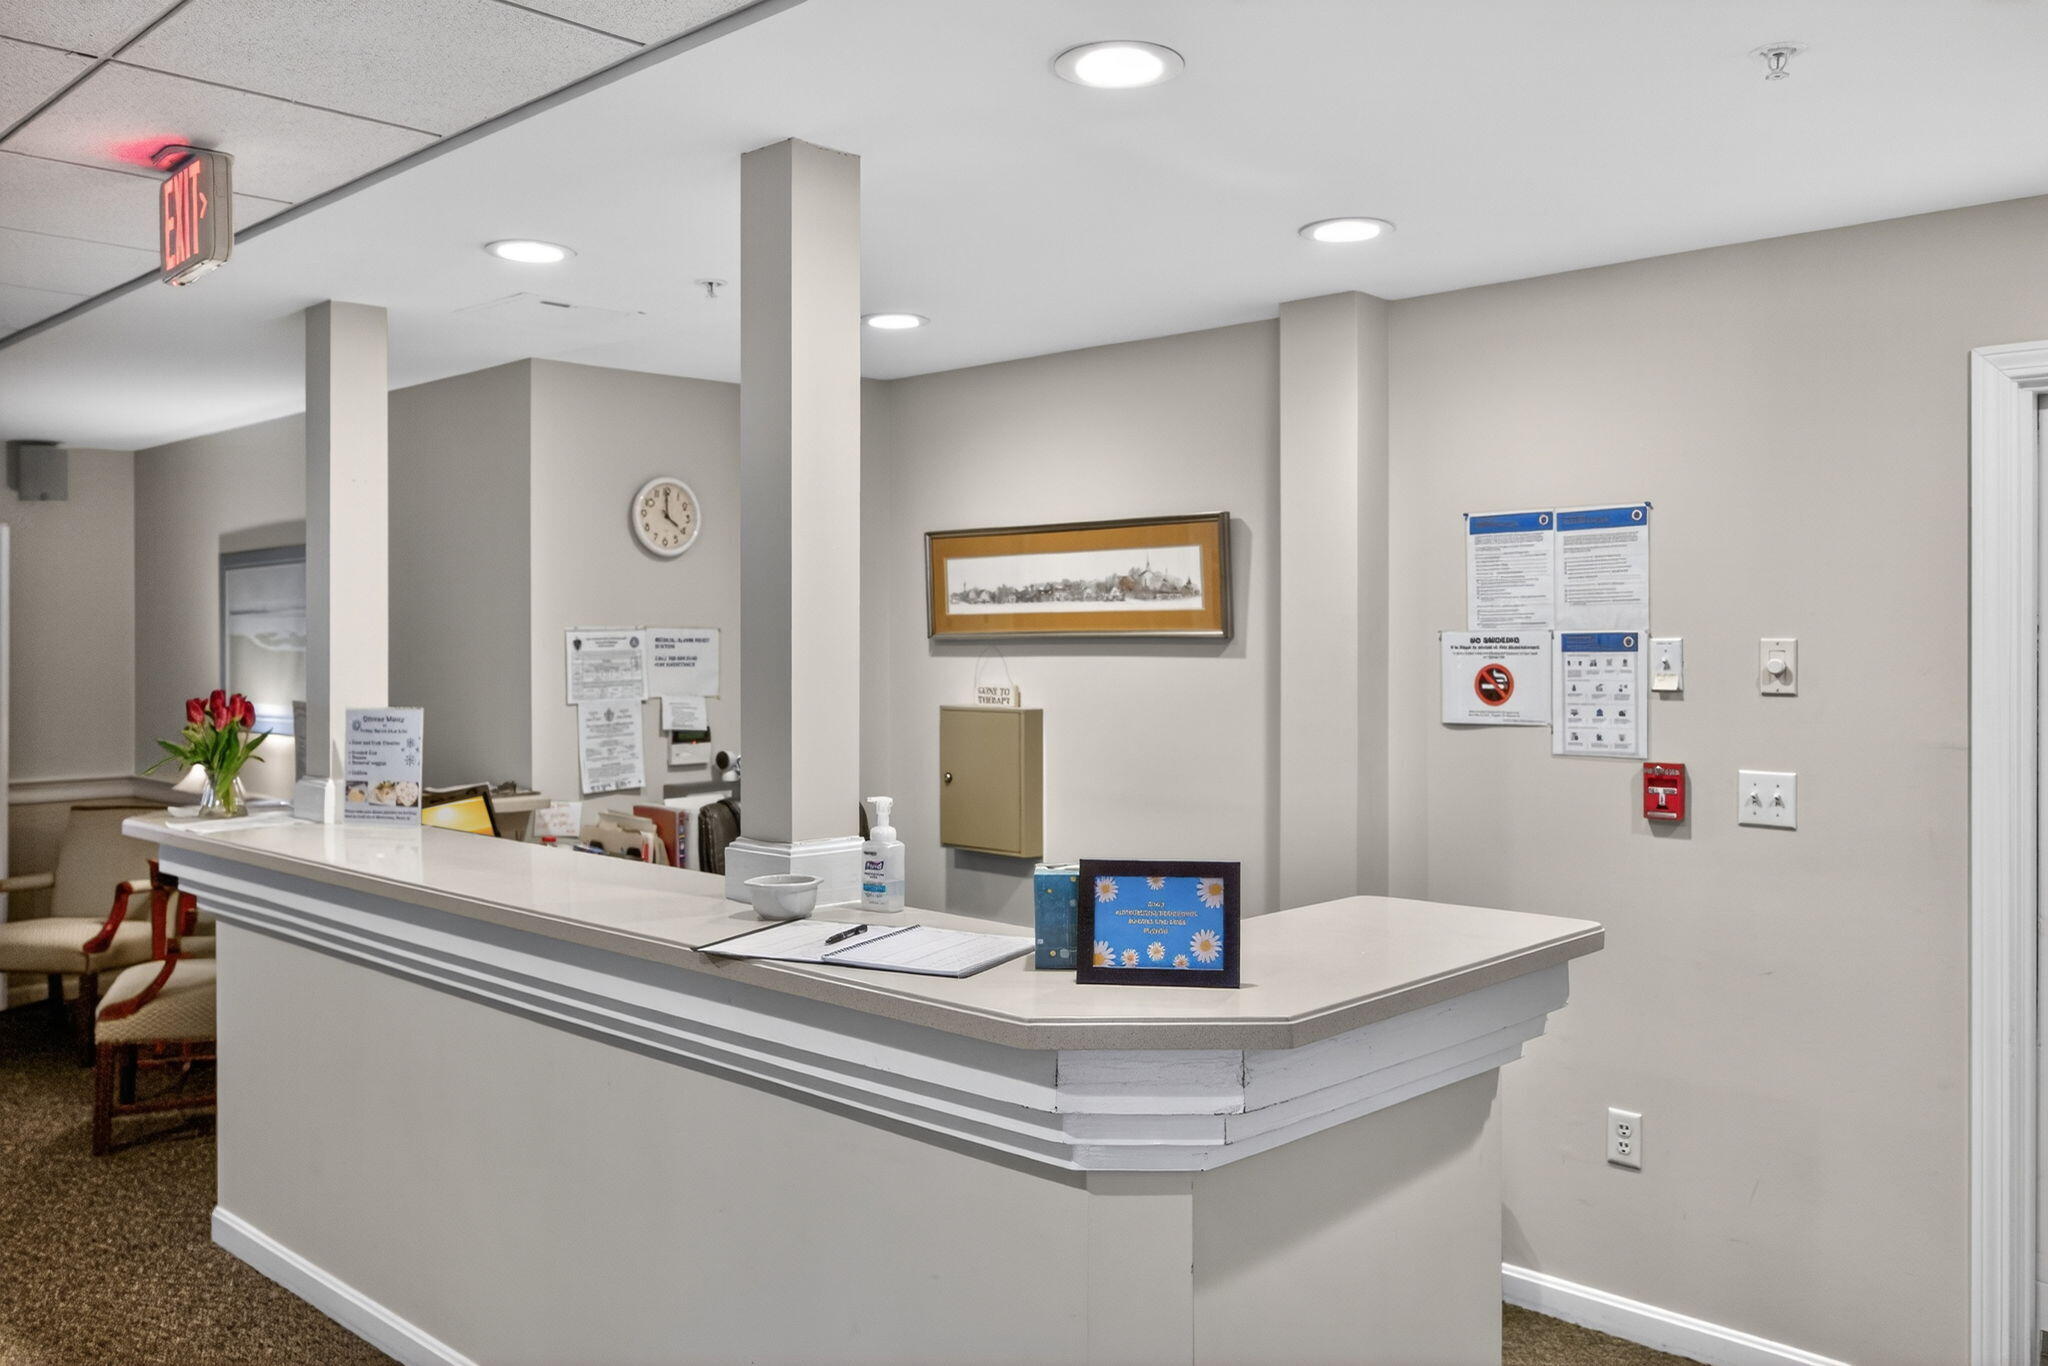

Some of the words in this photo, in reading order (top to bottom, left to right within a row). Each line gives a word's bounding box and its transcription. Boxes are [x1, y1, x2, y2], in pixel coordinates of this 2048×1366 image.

[163, 160, 201, 271] EXIT
[644, 498, 656, 508] 10
[1000, 687, 1010, 697] TO
